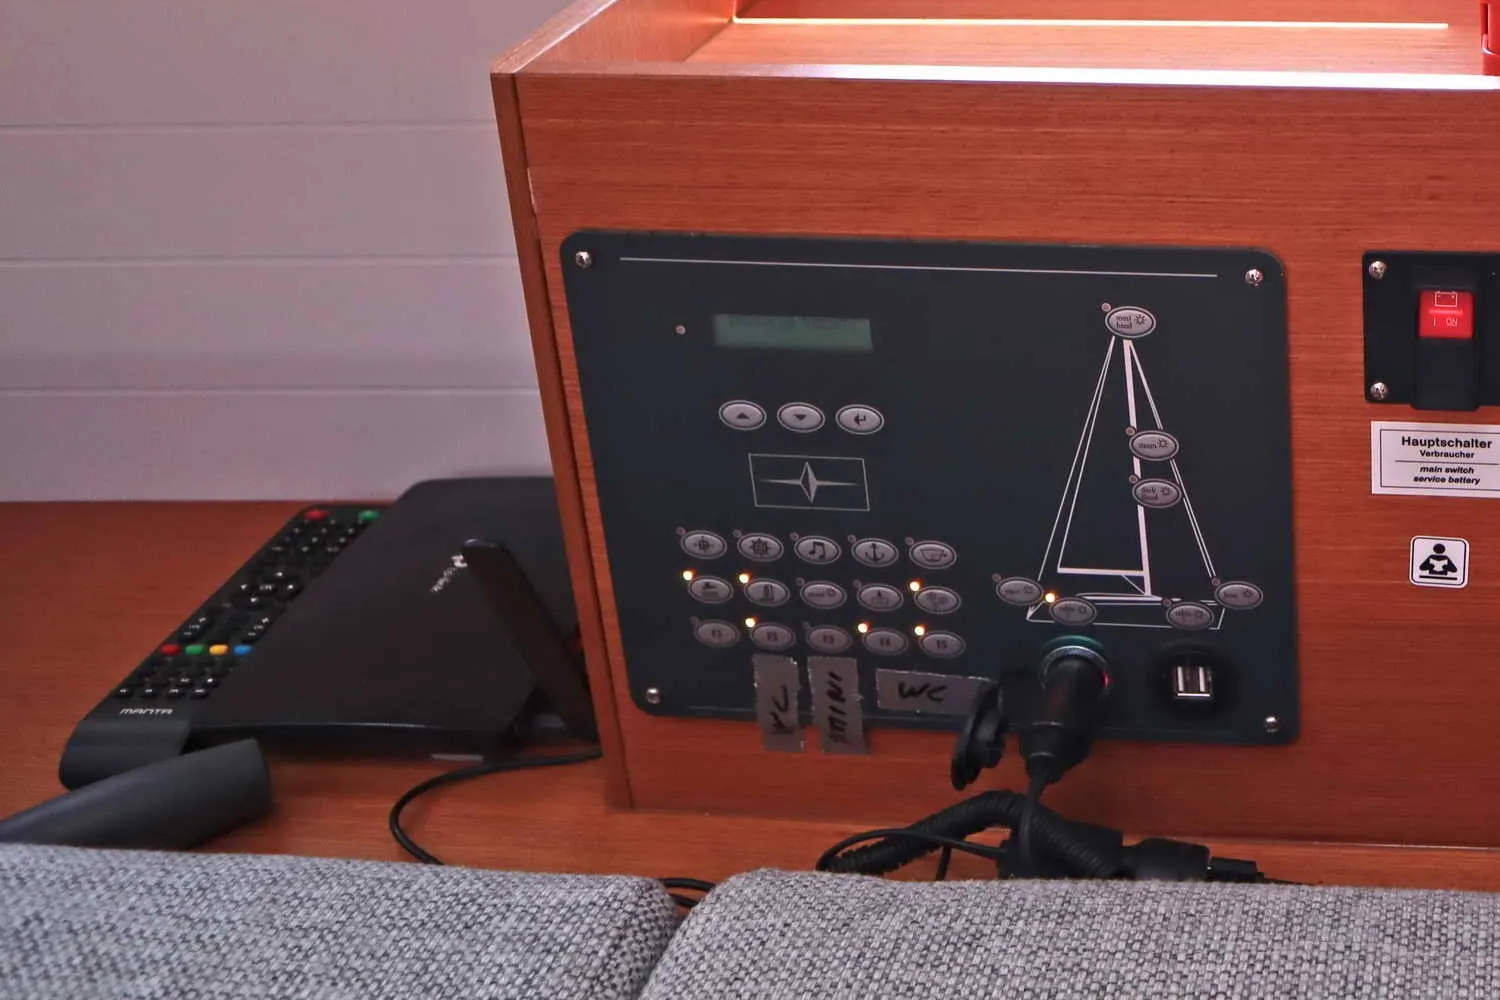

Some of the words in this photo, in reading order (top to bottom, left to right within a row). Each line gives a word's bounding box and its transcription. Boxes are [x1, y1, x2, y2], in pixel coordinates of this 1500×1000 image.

[1401, 436, 1493, 449] Hauptschalter
[1419, 450, 1475, 459] Verbraucher
[1419, 466, 1442, 474] main
[1444, 465, 1475, 475] switch
[1413, 475, 1446, 484] service
[1447, 476, 1481, 486] battery
[897, 681, 947, 703] WC
